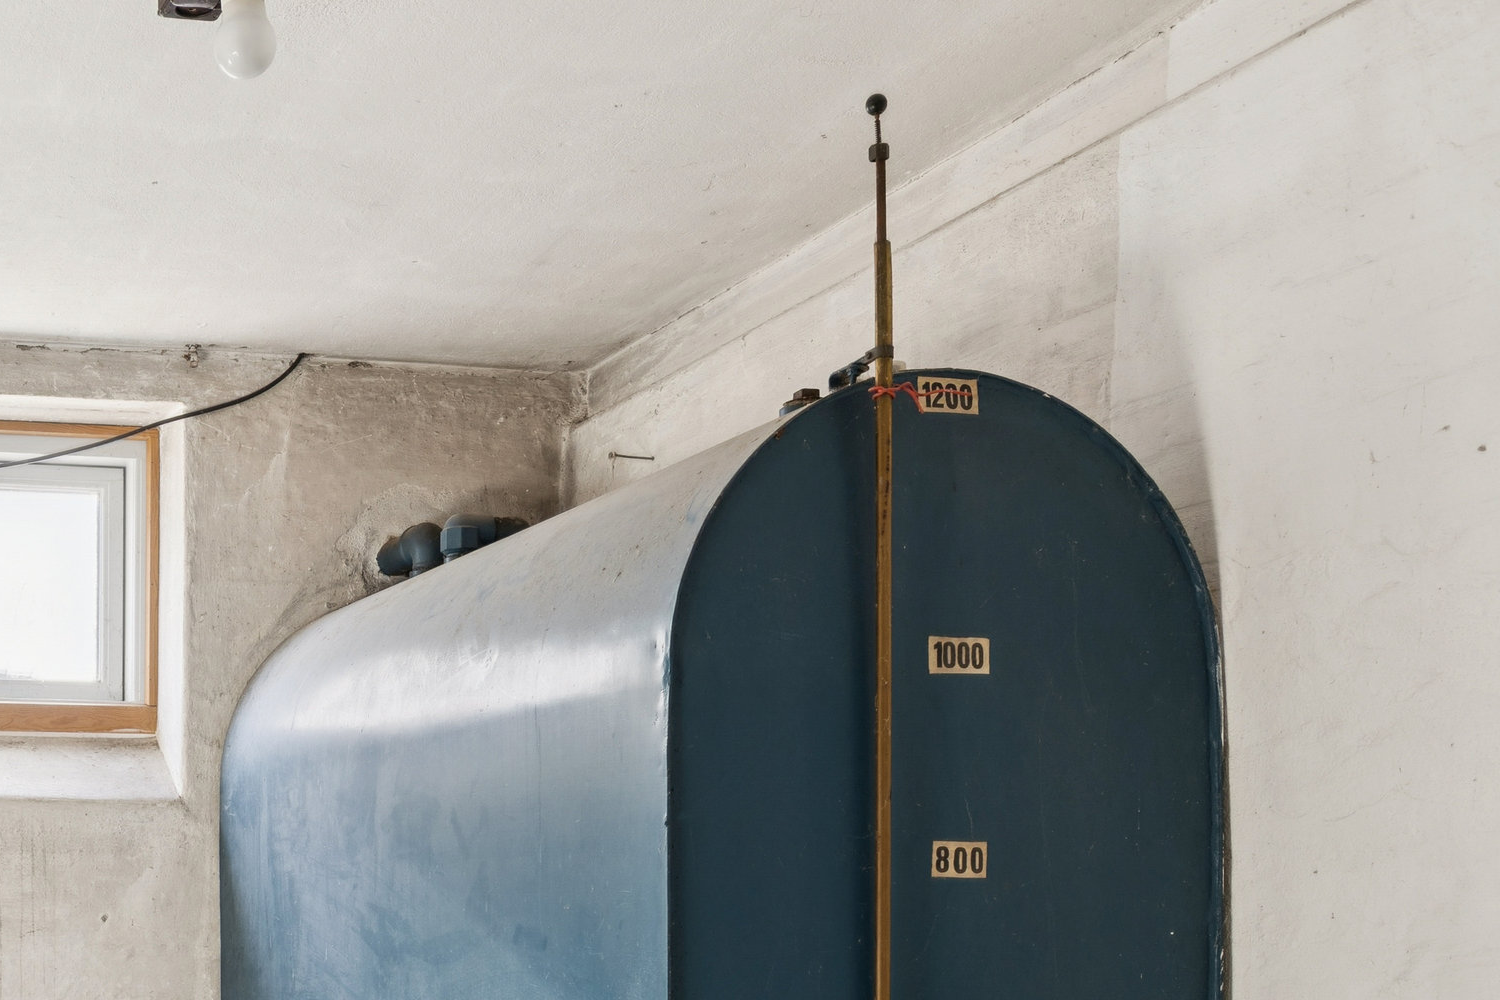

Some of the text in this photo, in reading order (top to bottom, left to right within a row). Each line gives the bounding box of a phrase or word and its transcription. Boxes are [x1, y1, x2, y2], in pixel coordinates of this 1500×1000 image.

[922, 382, 972, 411] 1200
[934, 642, 984, 669] 1000
[936, 846, 983, 874] 800
